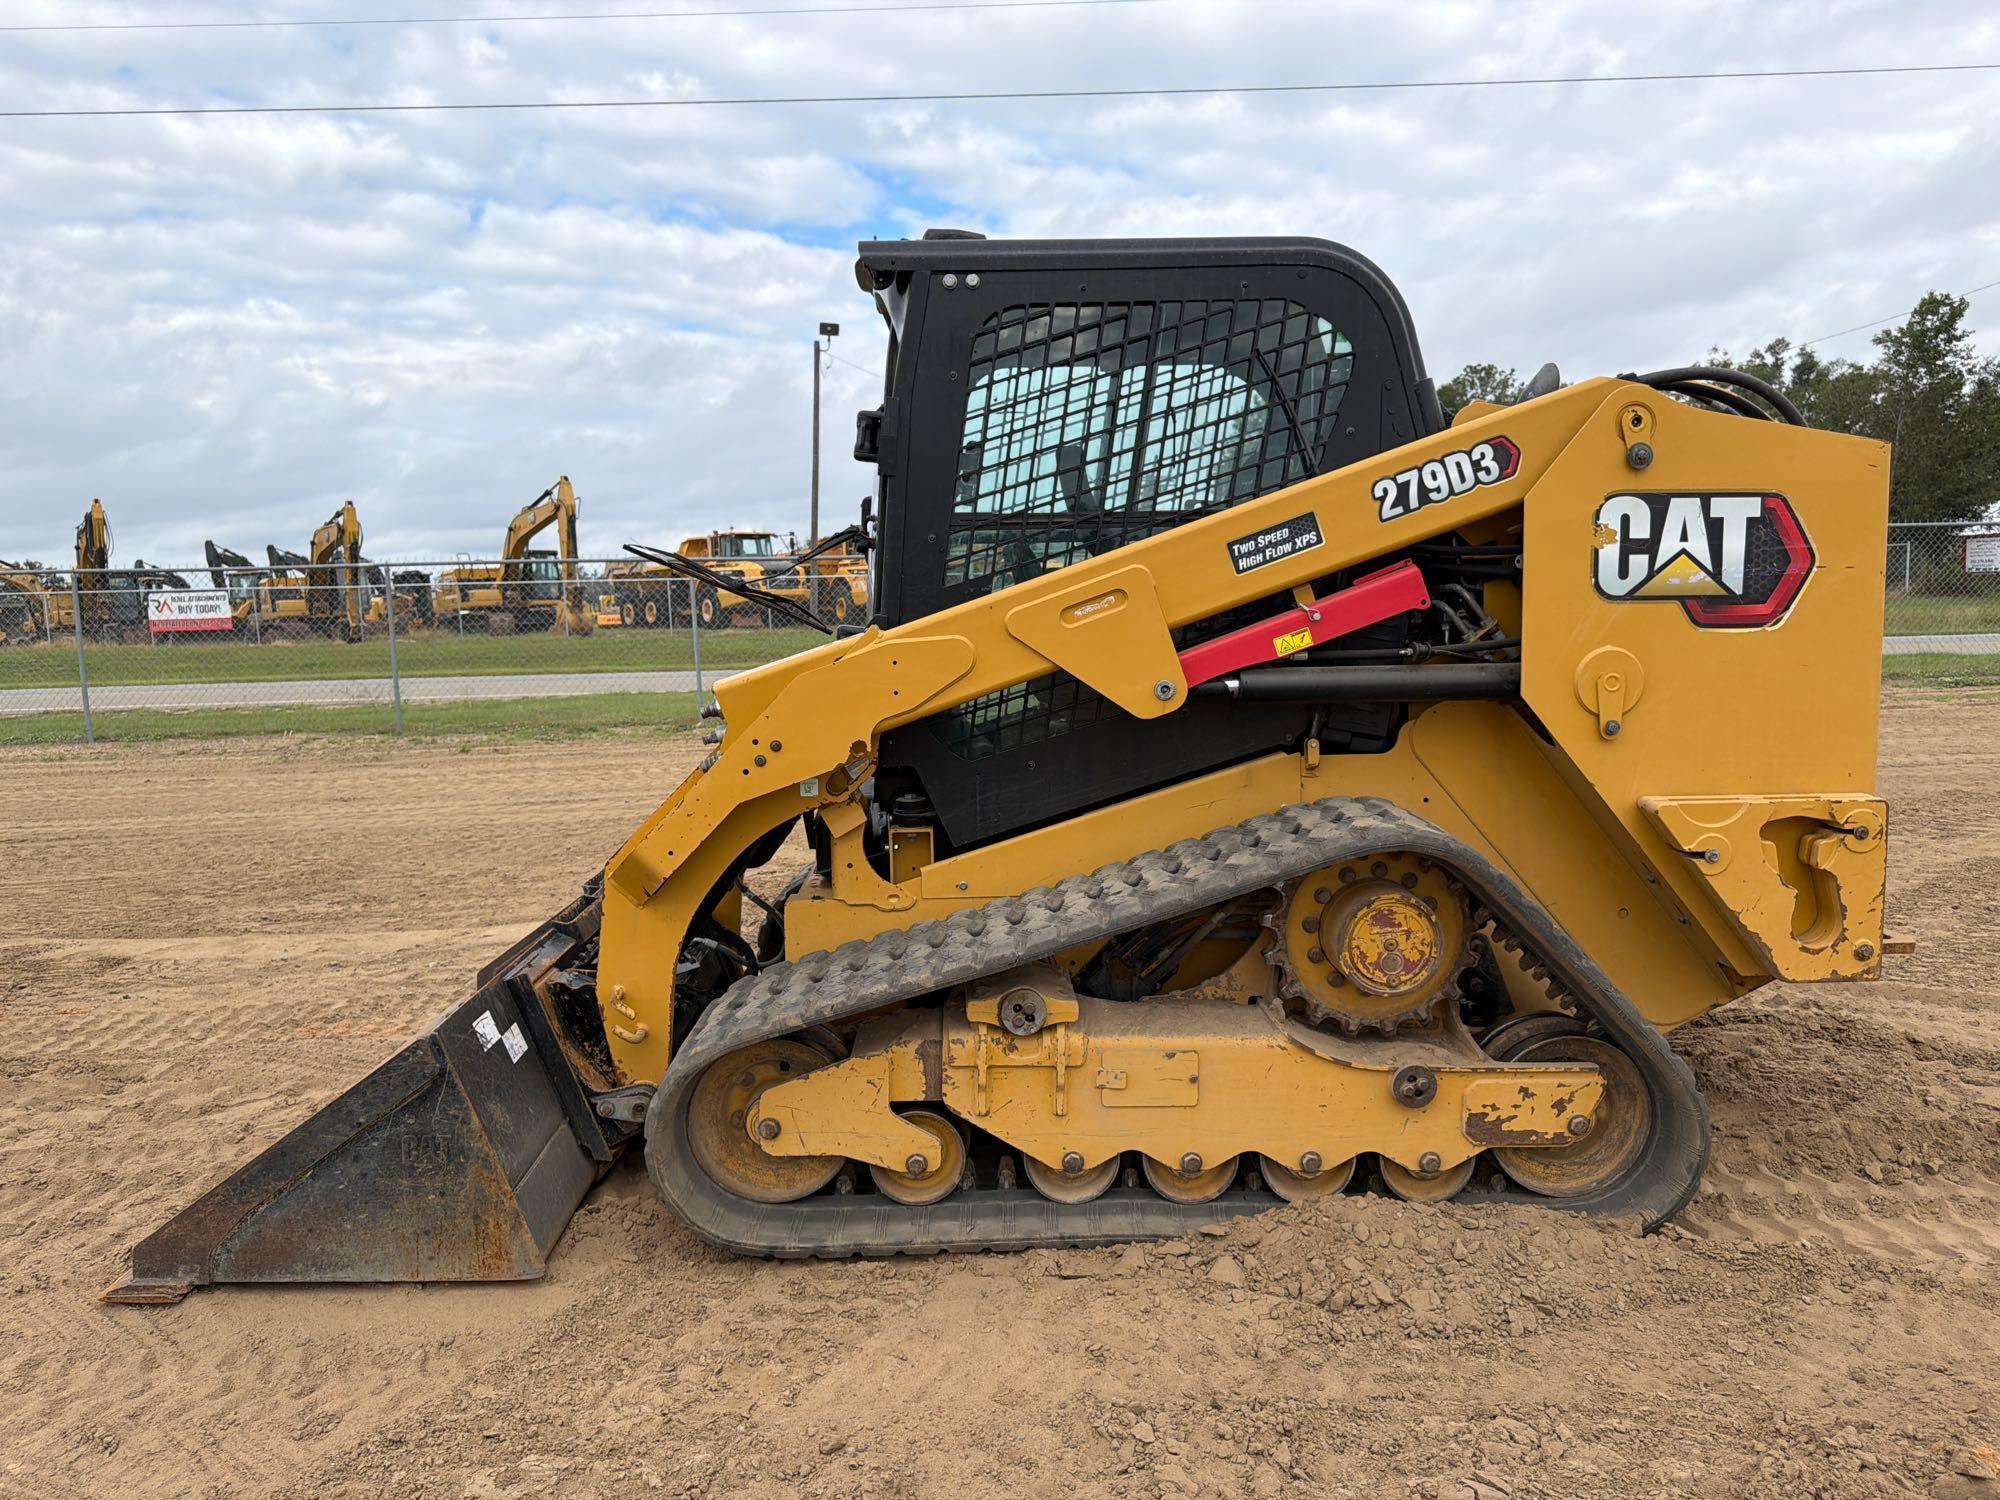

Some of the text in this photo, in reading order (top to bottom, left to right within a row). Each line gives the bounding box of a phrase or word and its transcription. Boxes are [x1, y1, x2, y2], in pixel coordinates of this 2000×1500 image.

[1373, 443, 1500, 520] 279D3
[1295, 531, 1317, 549] XPS
[1597, 496, 1762, 596] CAT
[178, 604, 222, 614] BUY TODAY!
[402, 1135, 451, 1170] CAT
